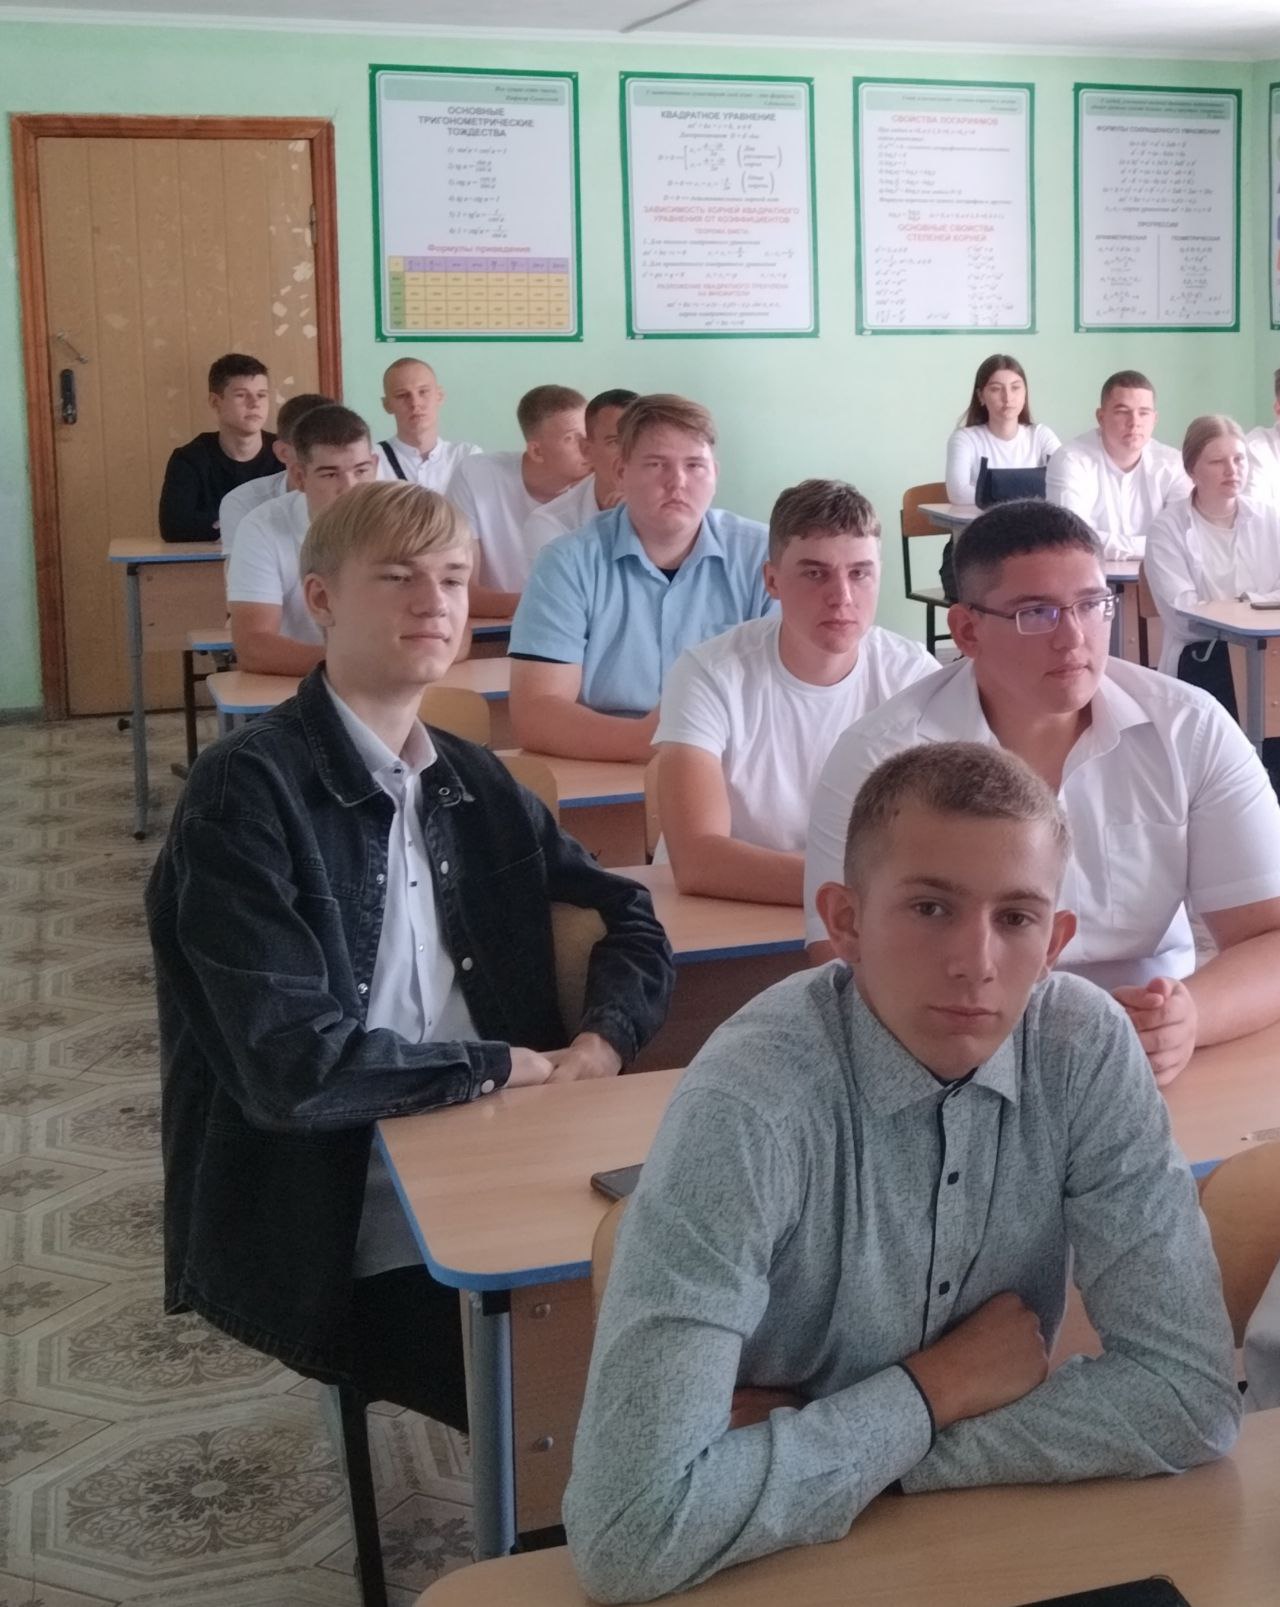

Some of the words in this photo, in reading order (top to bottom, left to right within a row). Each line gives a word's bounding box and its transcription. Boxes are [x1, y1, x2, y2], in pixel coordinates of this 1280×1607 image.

[447, 106, 505, 116] ОСНОВНЫЕ
[661, 110, 720, 120] КВАДРАТНОЕ
[723, 111, 776, 121] УРАВНЕНИЕ
[418, 115, 534, 128] ТРИГОНОМЕТРИЧЕСКИЕ
[447, 127, 507, 137] ТОЖДЕСТВА
